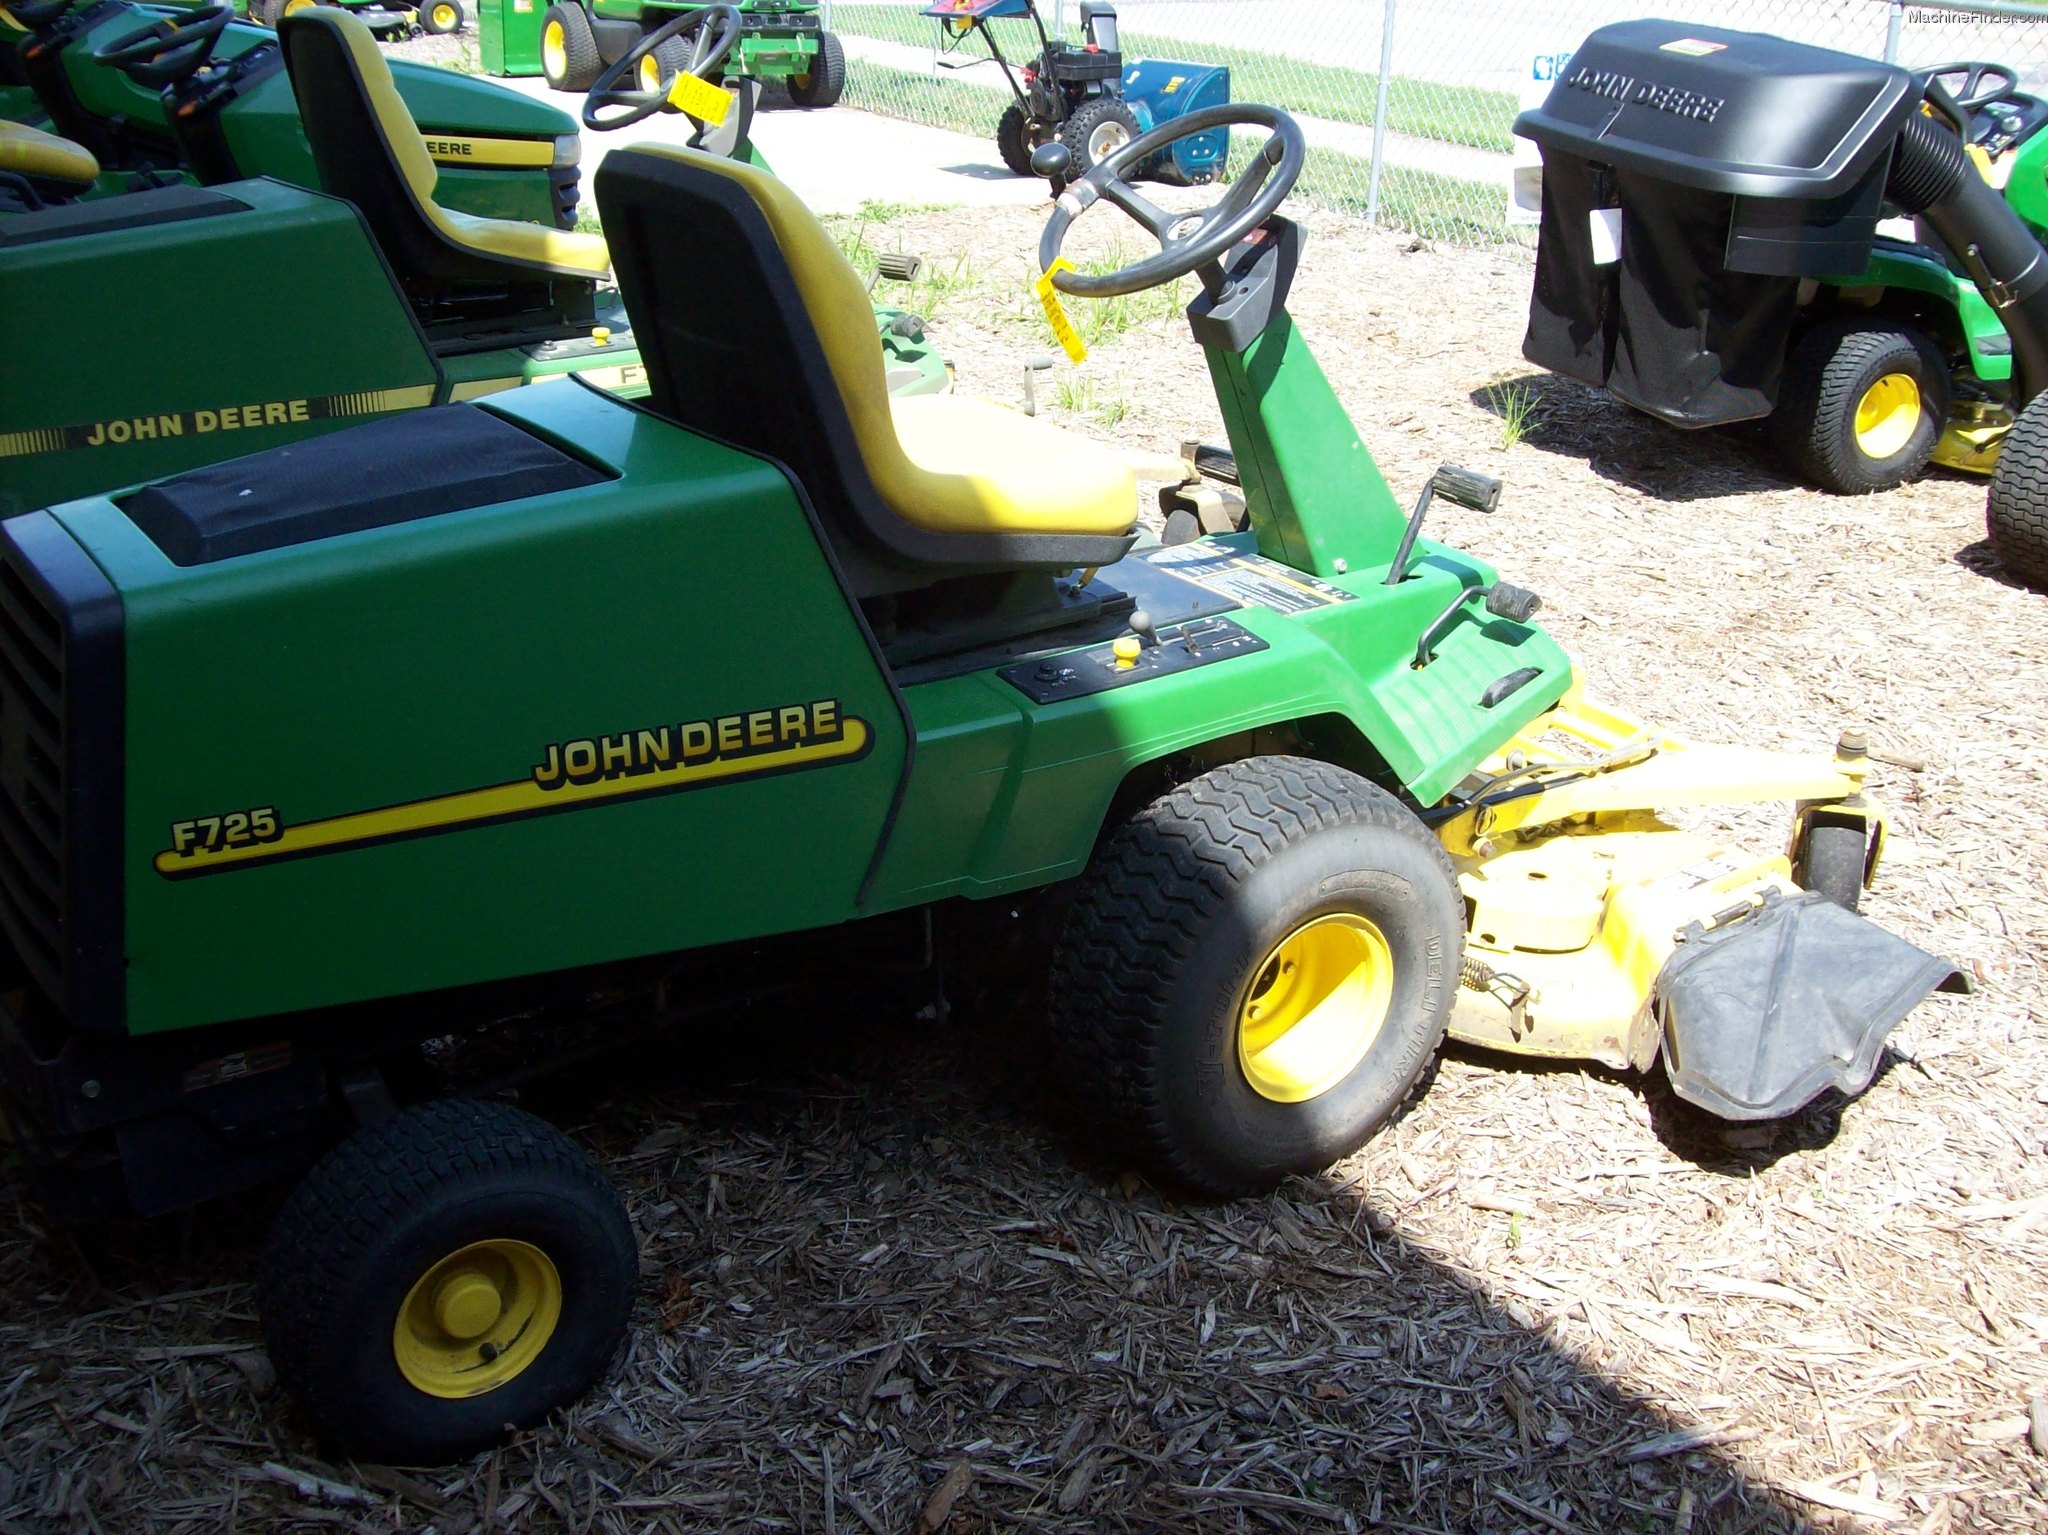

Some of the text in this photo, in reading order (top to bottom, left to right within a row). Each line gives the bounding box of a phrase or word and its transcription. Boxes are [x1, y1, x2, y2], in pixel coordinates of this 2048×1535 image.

[1568, 67, 1635, 101] JOHN
[1632, 81, 1725, 123] DEERE
[426, 142, 472, 155] EERE
[87, 399, 310, 446] JOHN DEERE
[533, 700, 838, 784] JOHN DEERE
[172, 807, 277, 851] F725
[1423, 934, 1442, 1013] DELI
